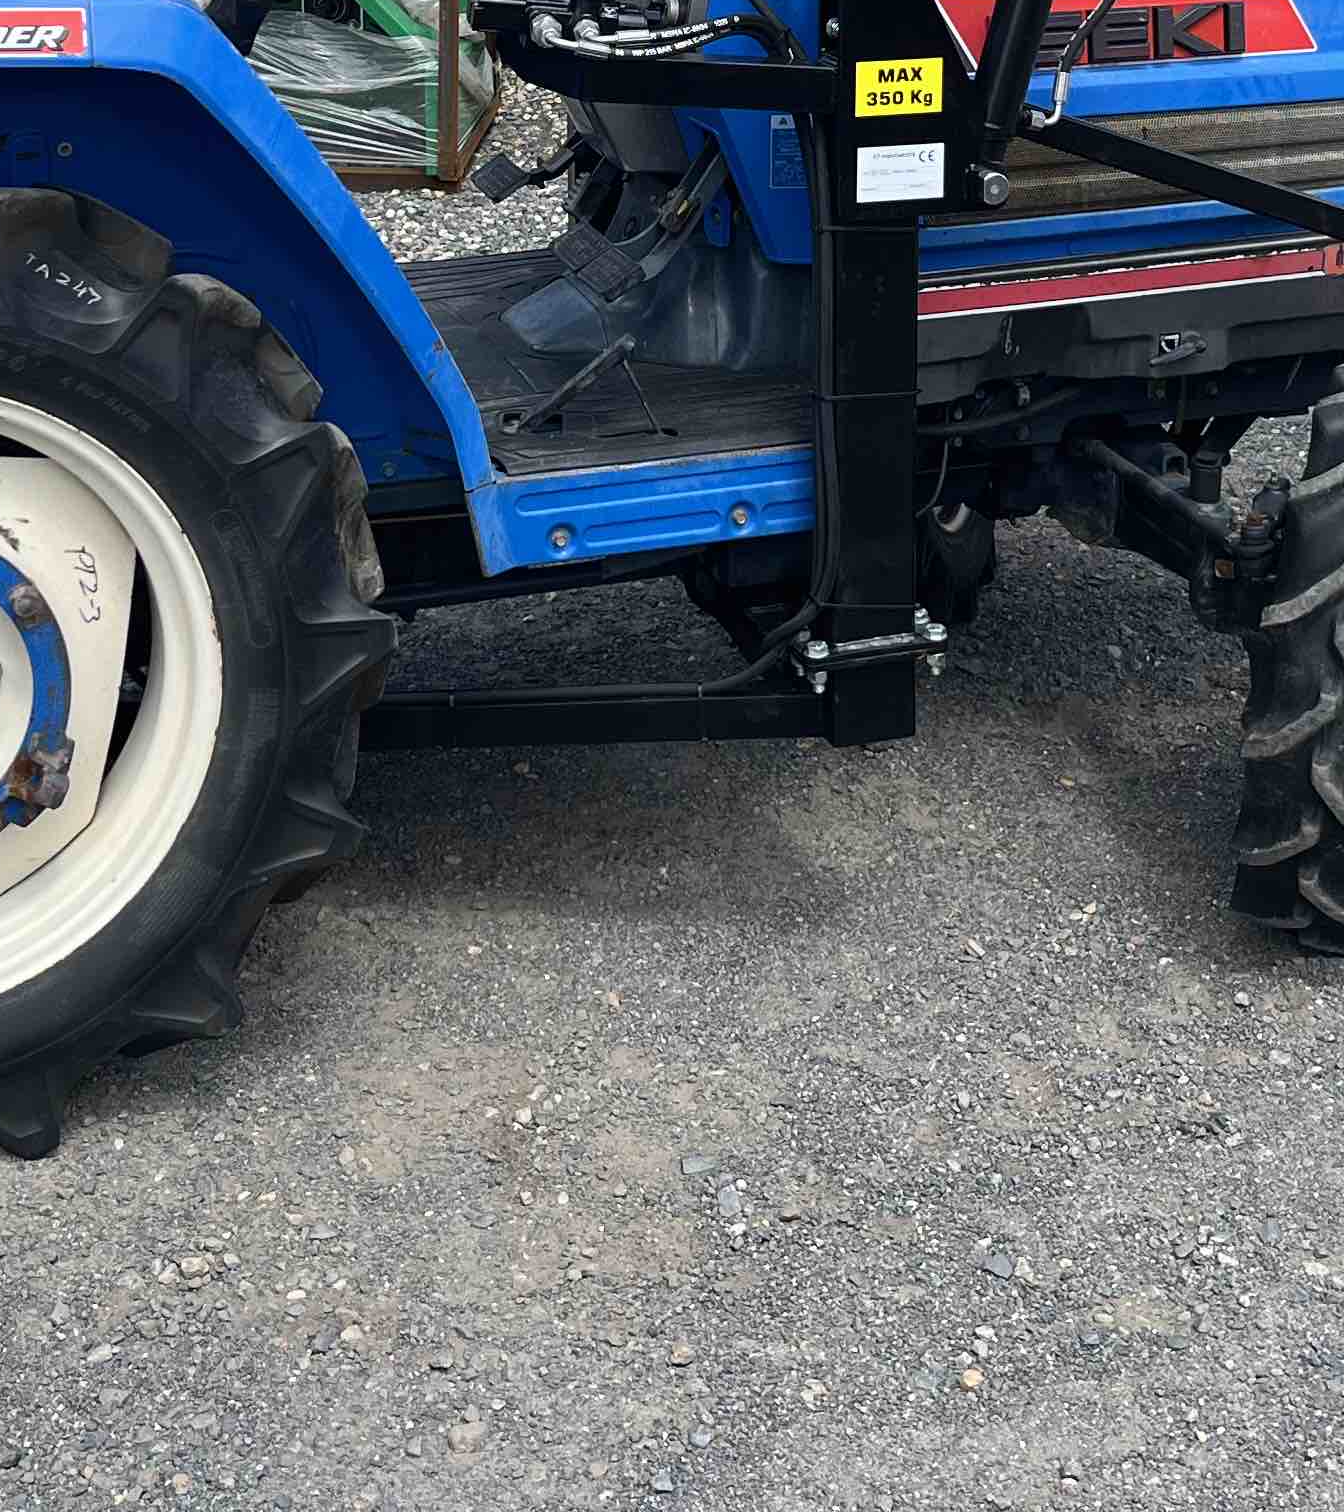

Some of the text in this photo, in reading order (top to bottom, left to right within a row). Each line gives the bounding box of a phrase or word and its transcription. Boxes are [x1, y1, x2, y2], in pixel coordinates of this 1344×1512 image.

[987, 0, 1247, 69] SEKI
[878, 67, 923, 84] MAX
[866, 89, 933, 106] 350 Kg
[918, 150, 936, 163] CE
